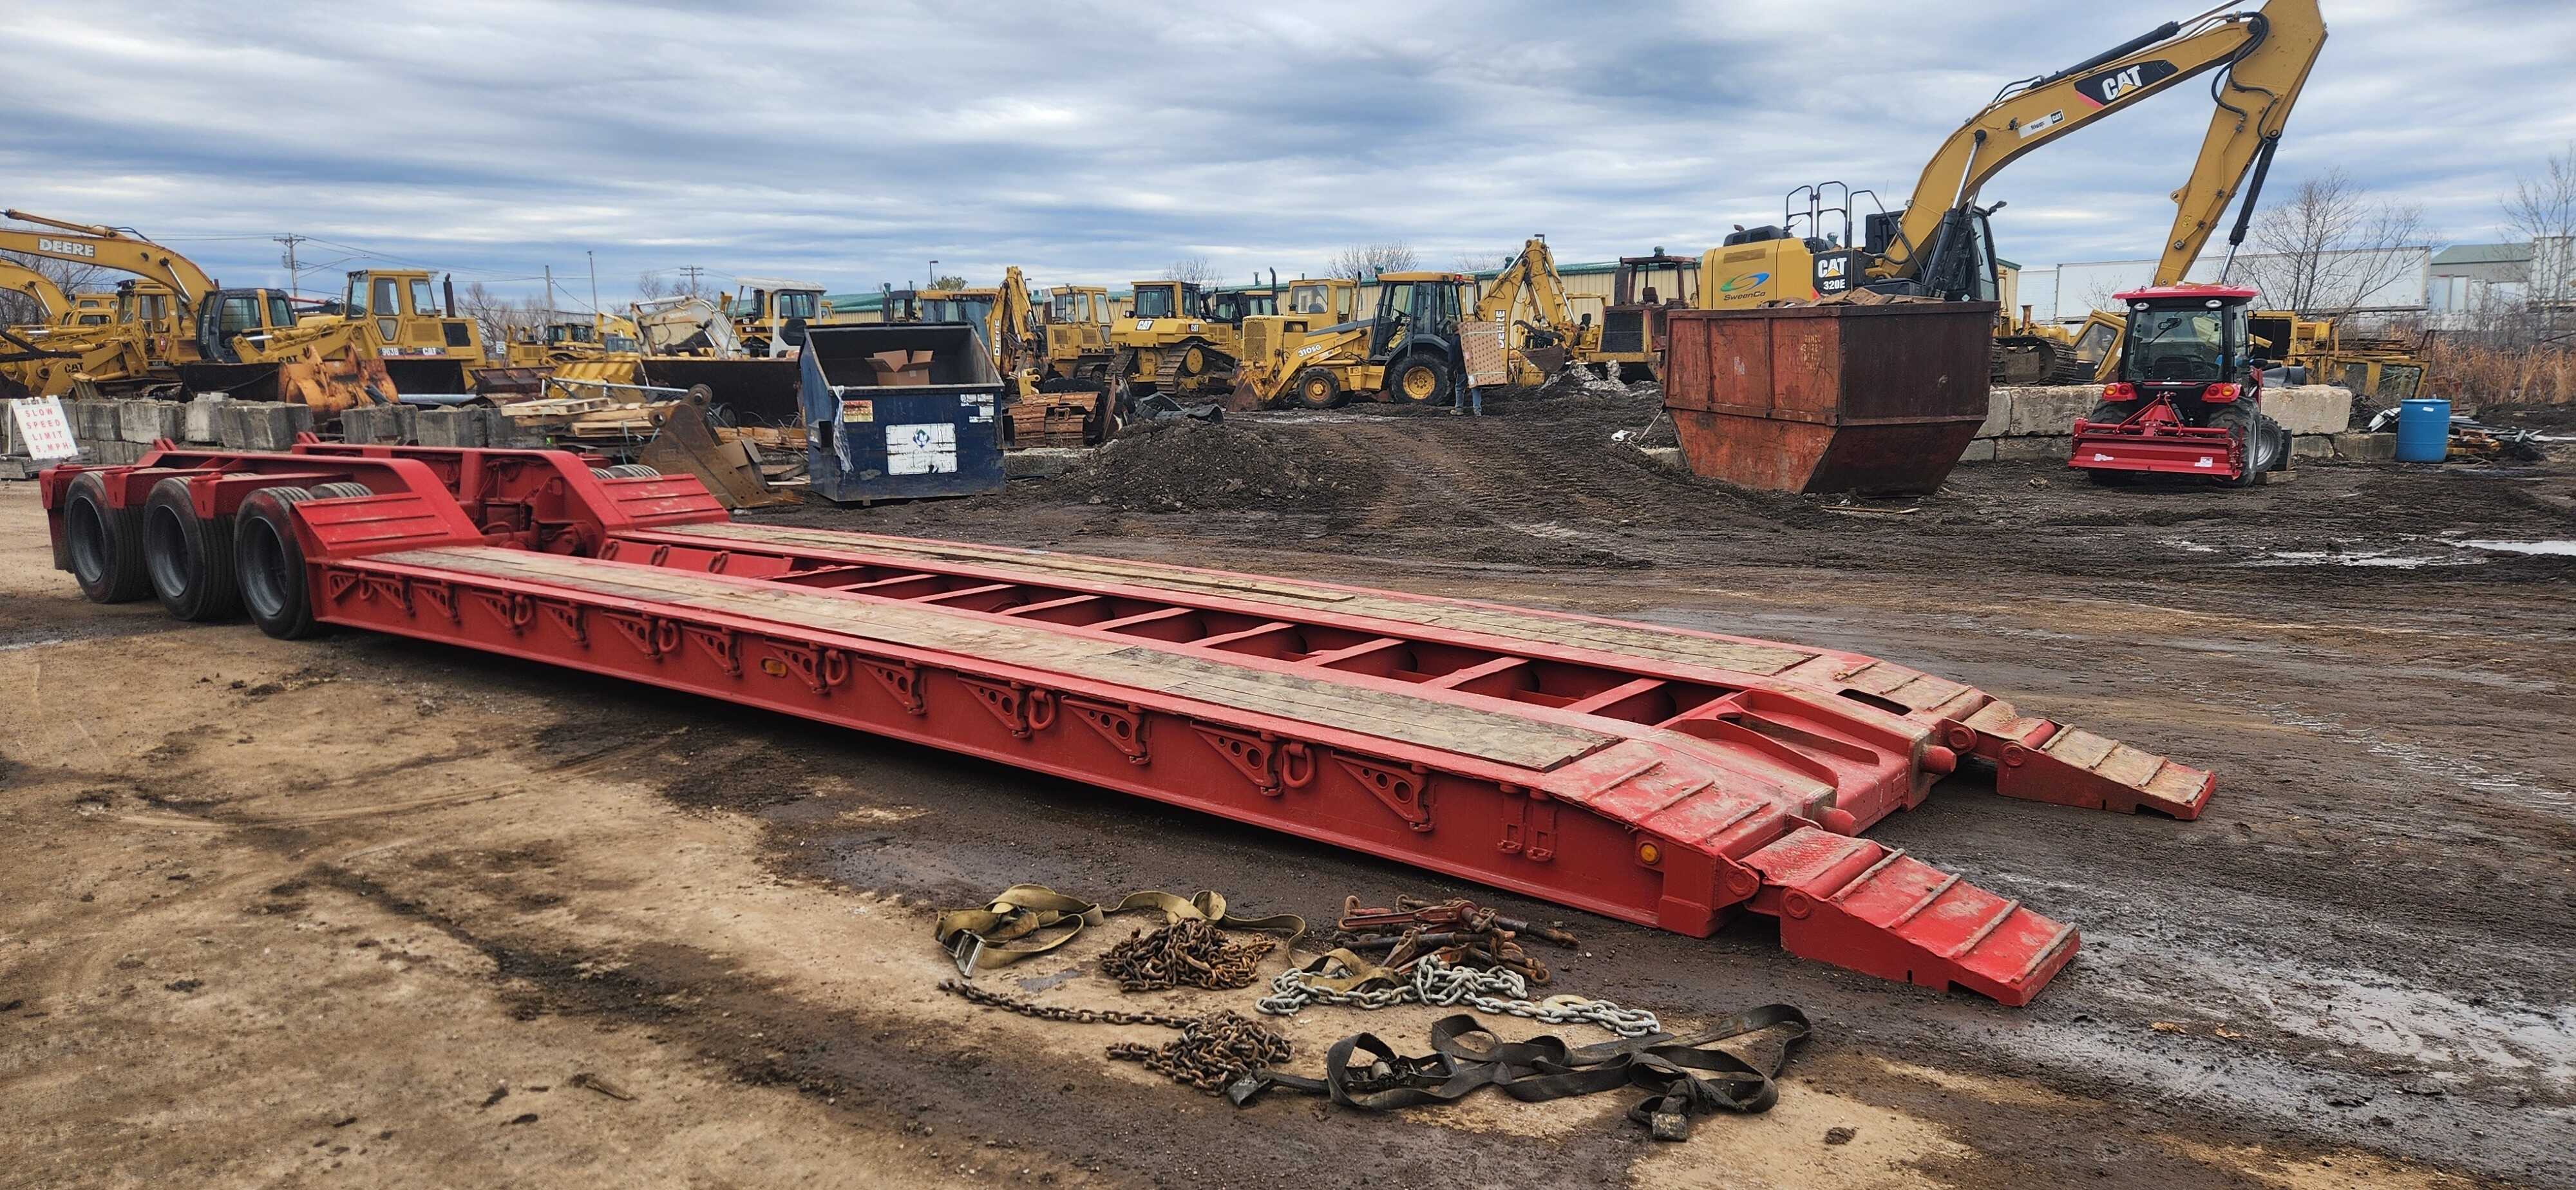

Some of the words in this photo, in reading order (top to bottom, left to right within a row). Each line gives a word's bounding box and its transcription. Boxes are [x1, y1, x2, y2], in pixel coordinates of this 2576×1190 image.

[2101, 64, 2143, 100] CAT
[39, 238, 95, 258] DEERE
[1818, 257, 1848, 278] CAT
[1823, 279, 1846, 290] 320E
[1723, 291, 1766, 301] SweenCo
[1137, 320, 1153, 330] CAT
[1191, 324, 1199, 332] CAT
[422, 346, 437, 355] CAT
[1298, 344, 1321, 357] 310SG
[64, 362, 84, 373] CAT
[25, 408, 53, 417] SLOW
[26, 419, 61, 430] SPEED
[32, 431, 62, 440] LIMIT
